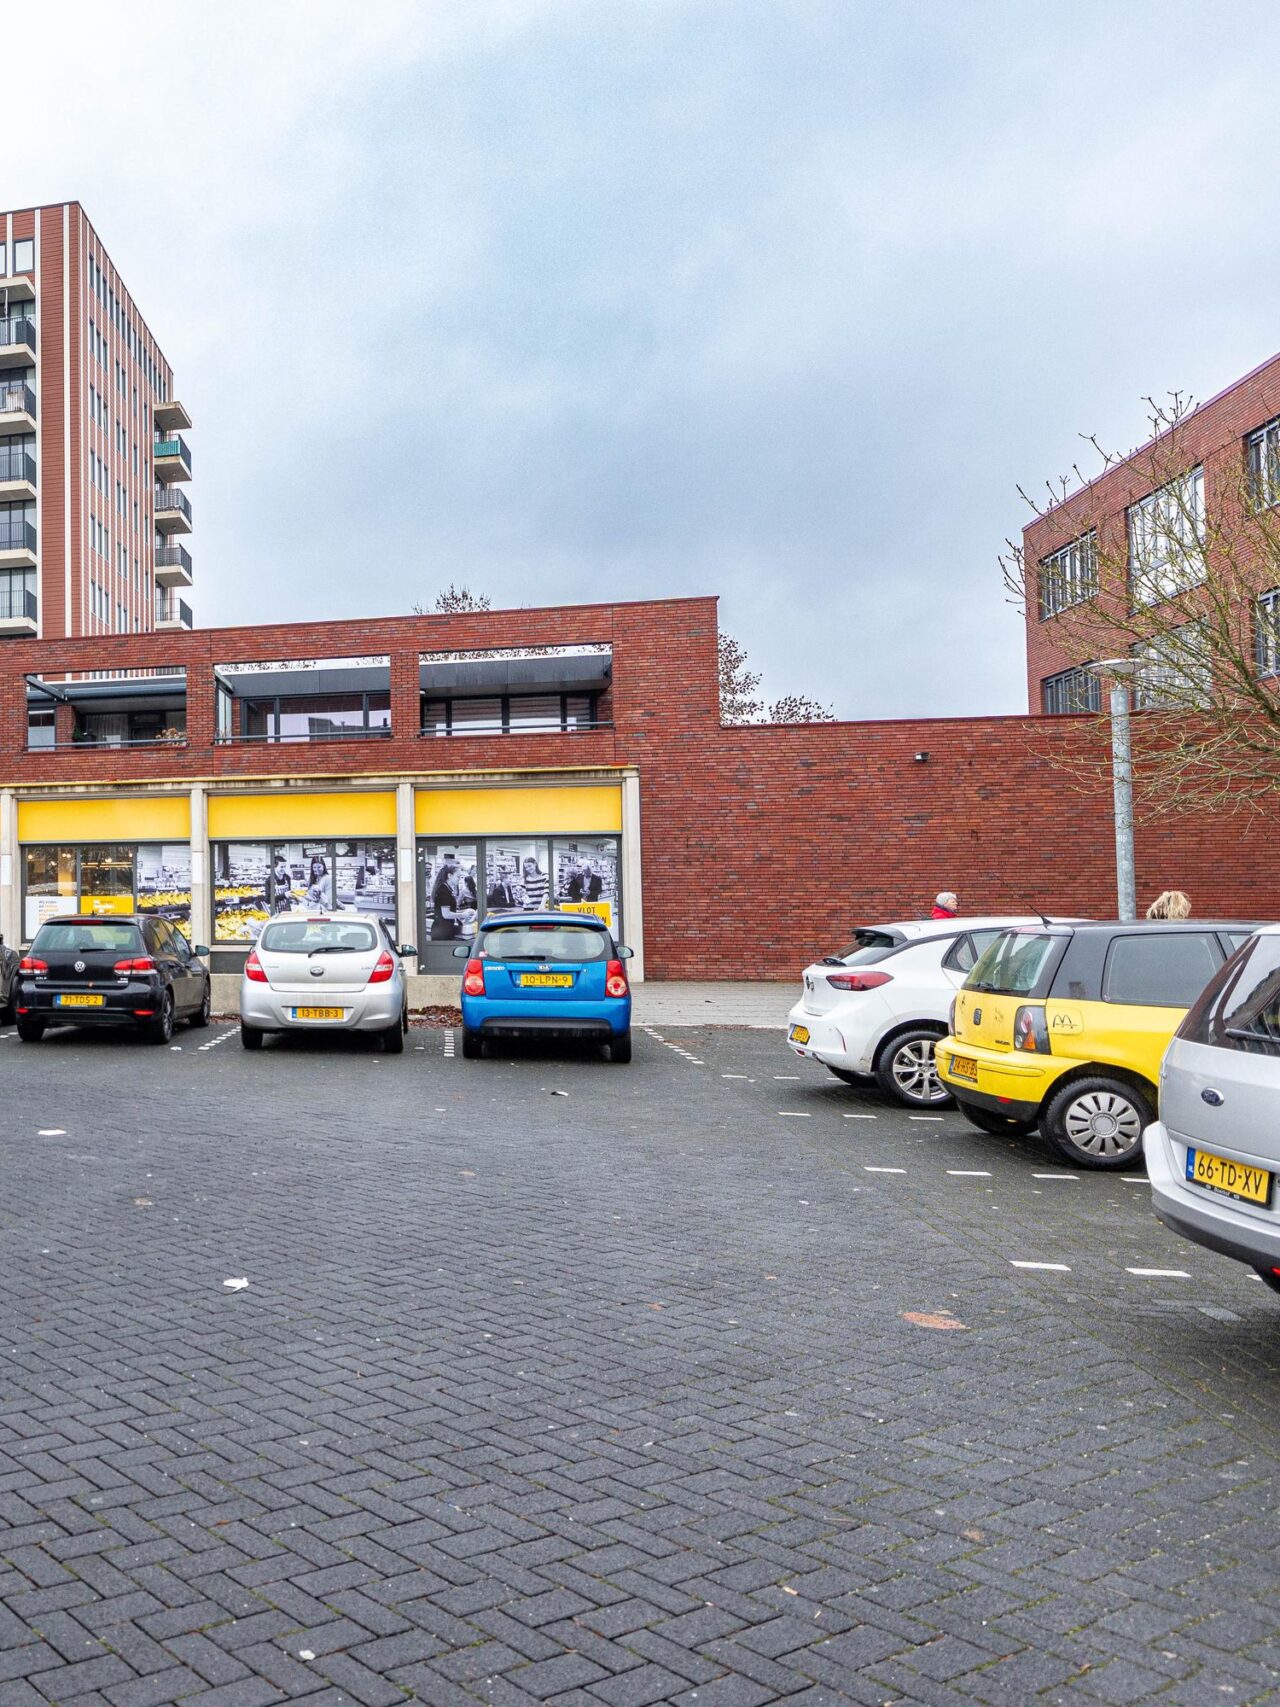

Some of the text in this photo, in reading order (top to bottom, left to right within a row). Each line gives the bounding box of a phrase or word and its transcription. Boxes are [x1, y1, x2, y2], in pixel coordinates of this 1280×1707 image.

[577, 907, 596, 915] VLOT
[524, 975, 568, 984] 10-LPN-9
[64, 996, 98, 1004] 71-TDS-2
[301, 1009, 338, 1018] 13-TBB-3
[1197, 1155, 1263, 1195] 66-TD-XV
